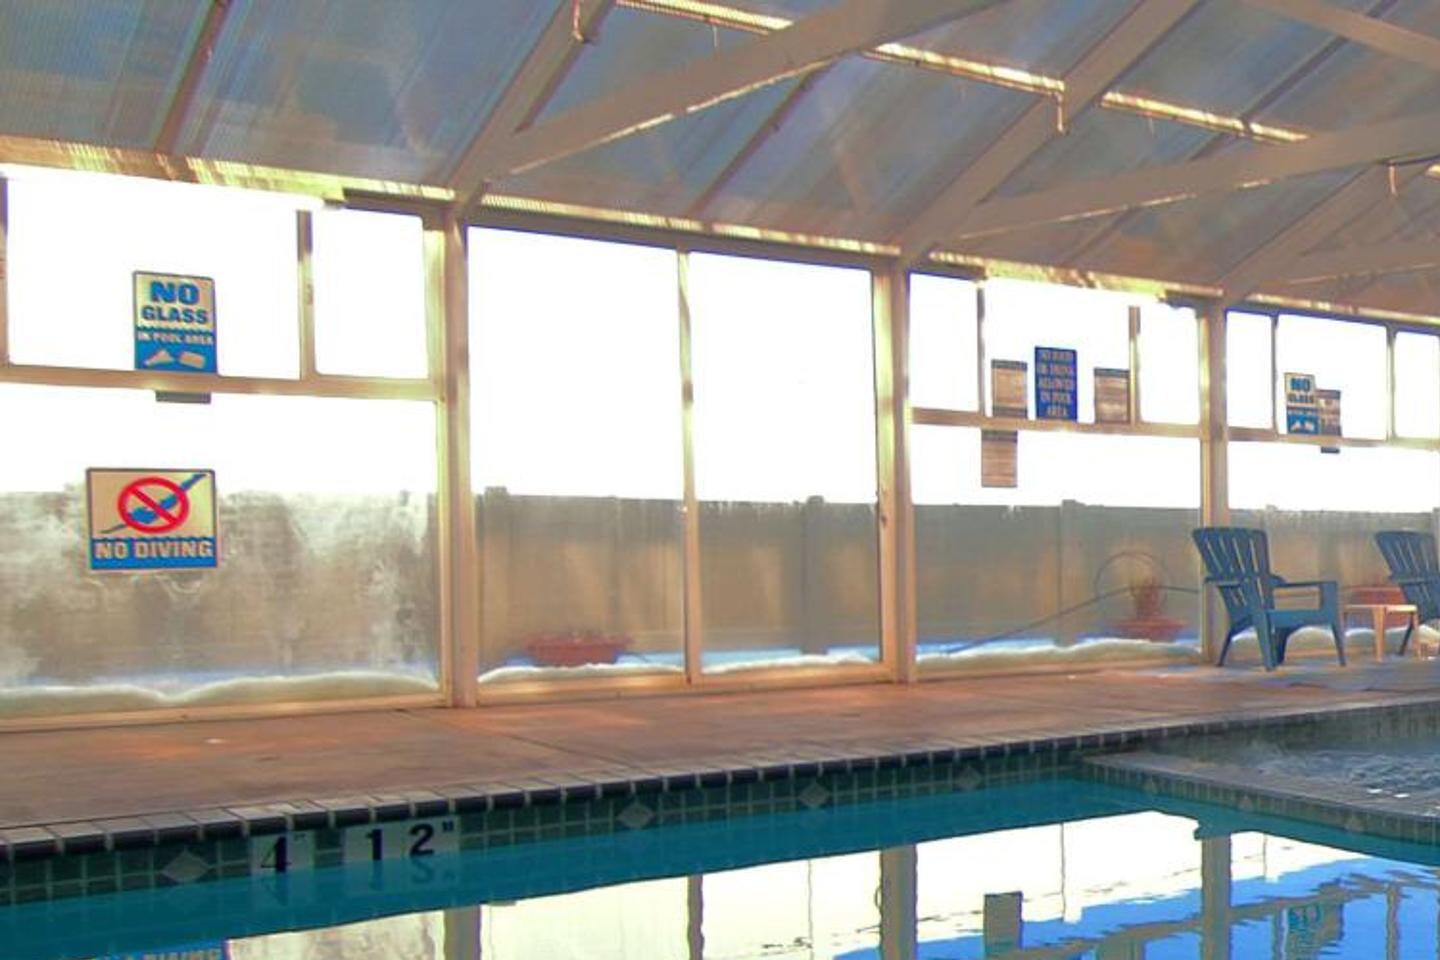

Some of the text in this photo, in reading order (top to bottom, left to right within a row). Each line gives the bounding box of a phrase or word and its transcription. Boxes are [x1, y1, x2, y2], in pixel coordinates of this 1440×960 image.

[150, 281, 199, 304] NO
[142, 305, 207, 324] GLASS
[1290, 378, 1310, 391] NO
[94, 540, 215, 560] NO DIVING
[260, 836, 291, 872] 4
